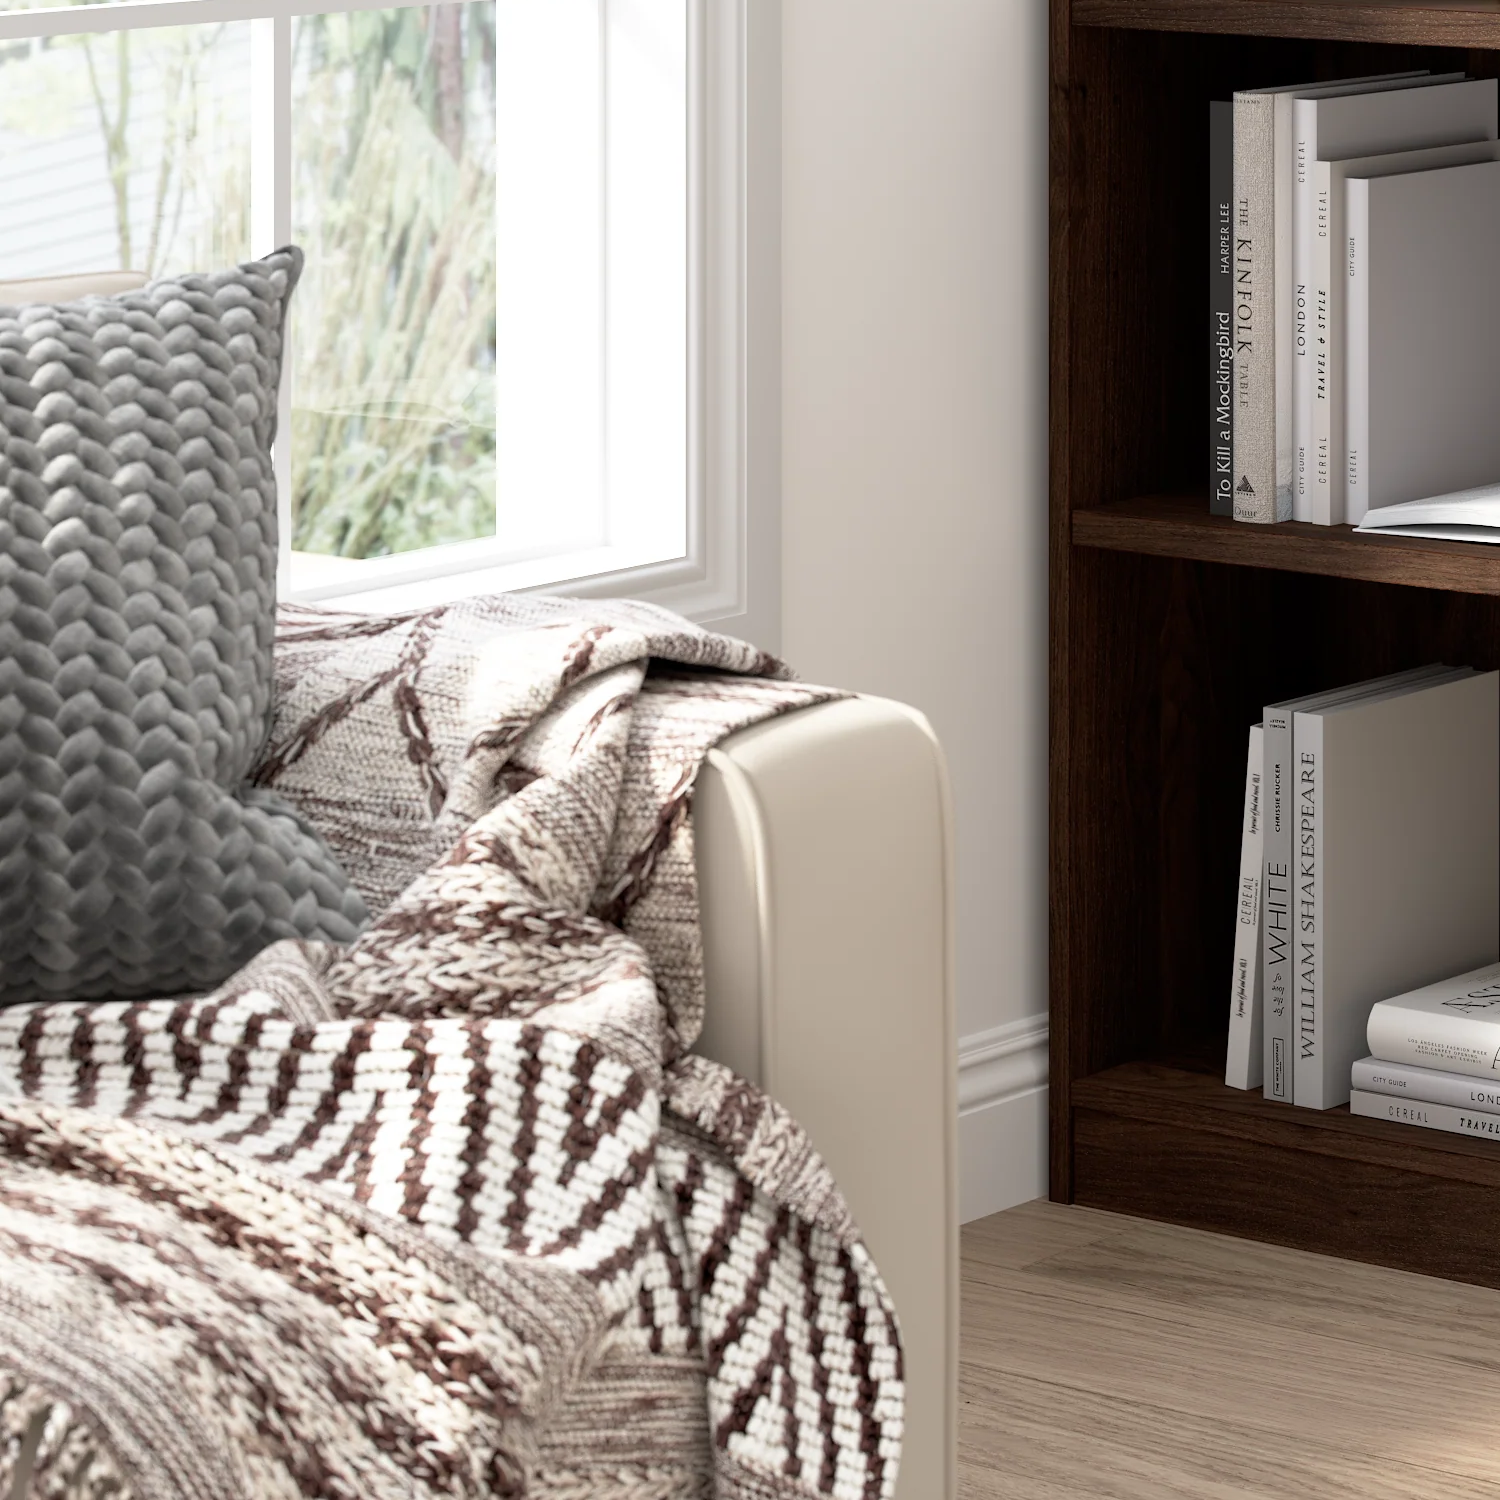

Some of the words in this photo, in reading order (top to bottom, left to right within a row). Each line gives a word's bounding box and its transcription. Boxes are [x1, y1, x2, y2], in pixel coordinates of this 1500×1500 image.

[1220, 202, 1230, 224] LEE
[1239, 198, 1248, 227] THE
[1221, 227, 1230, 274] HARPER
[1237, 238, 1253, 353] KINFOLK
[1297, 284, 1306, 356] LONDON
[1216, 311, 1234, 425] Mockingbird
[1239, 363, 1249, 408] TABLE
[1220, 430, 1231, 441] a
[1216, 446, 1231, 473] Kill
[1216, 479, 1231, 501] To
[1301, 752, 1315, 933] SHAKESPEARE
[1268, 862, 1287, 965] WHITE
[1301, 941, 1315, 1060] WILLIAM
[1388, 1105, 1429, 1124] CEREAL
[1460, 1117, 1500, 1135] TRAVEL
